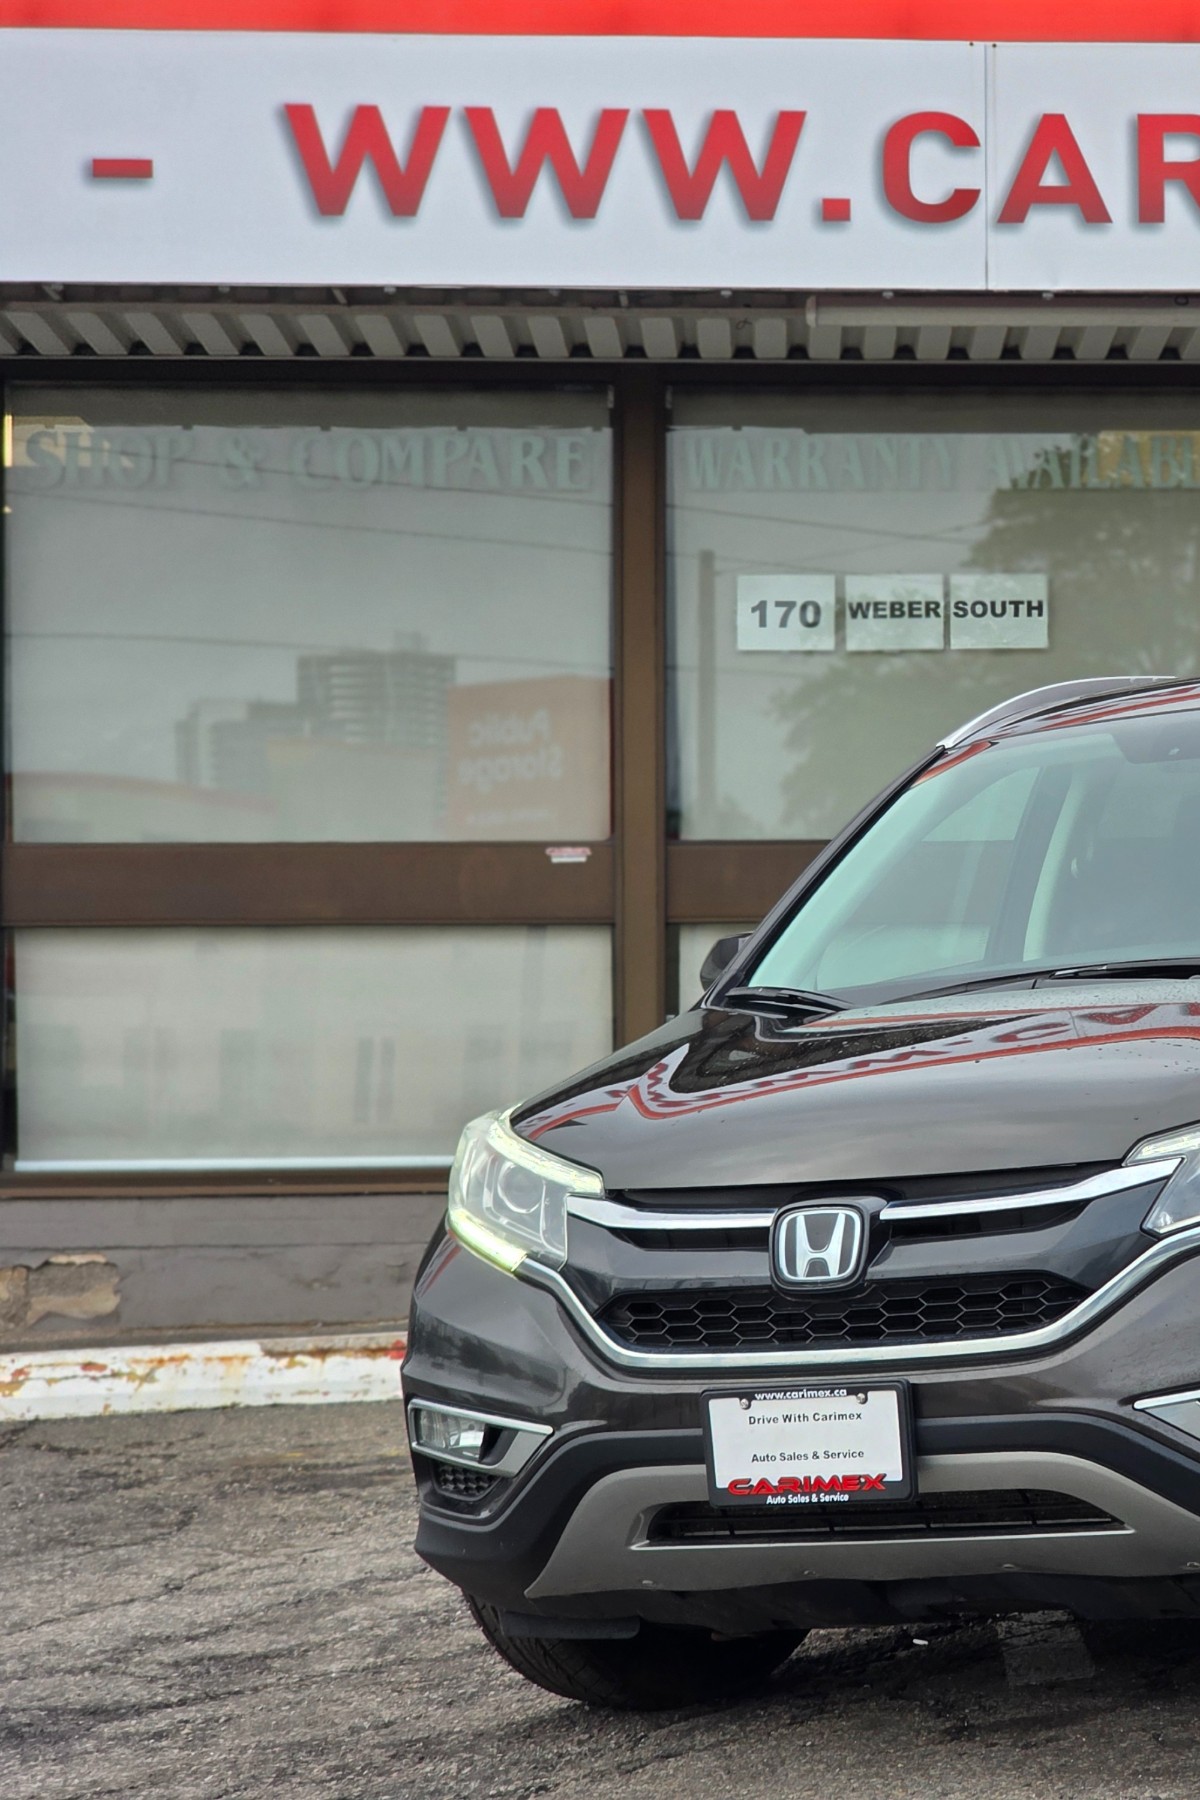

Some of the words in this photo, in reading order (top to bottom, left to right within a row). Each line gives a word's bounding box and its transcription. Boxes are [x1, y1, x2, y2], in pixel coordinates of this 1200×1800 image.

[25, 430, 192, 490] SHOP
[219, 434, 264, 490] &
[292, 432, 595, 491] COMPARE
[686, 434, 957, 490] WARRANTY
[750, 600, 821, 629] 170
[847, 599, 942, 620] WEBER
[952, 599, 1044, 619] SOUTH
[754, 1388, 848, 1401] www.carimex.ca
[749, 1414, 779, 1425] Drive
[782, 1412, 810, 1423] With
[813, 1411, 862, 1422] Carimex
[751, 1452, 777, 1463] Auto
[779, 1451, 809, 1462] Sales
[811, 1451, 820, 1460] &
[823, 1449, 865, 1459] Service
[728, 1473, 887, 1495] CARIMEX
[766, 1494, 787, 1505] Auto
[787, 1493, 810, 1504] Sales
[811, 1492, 819, 1502] &
[820, 1491, 850, 1502] Service
